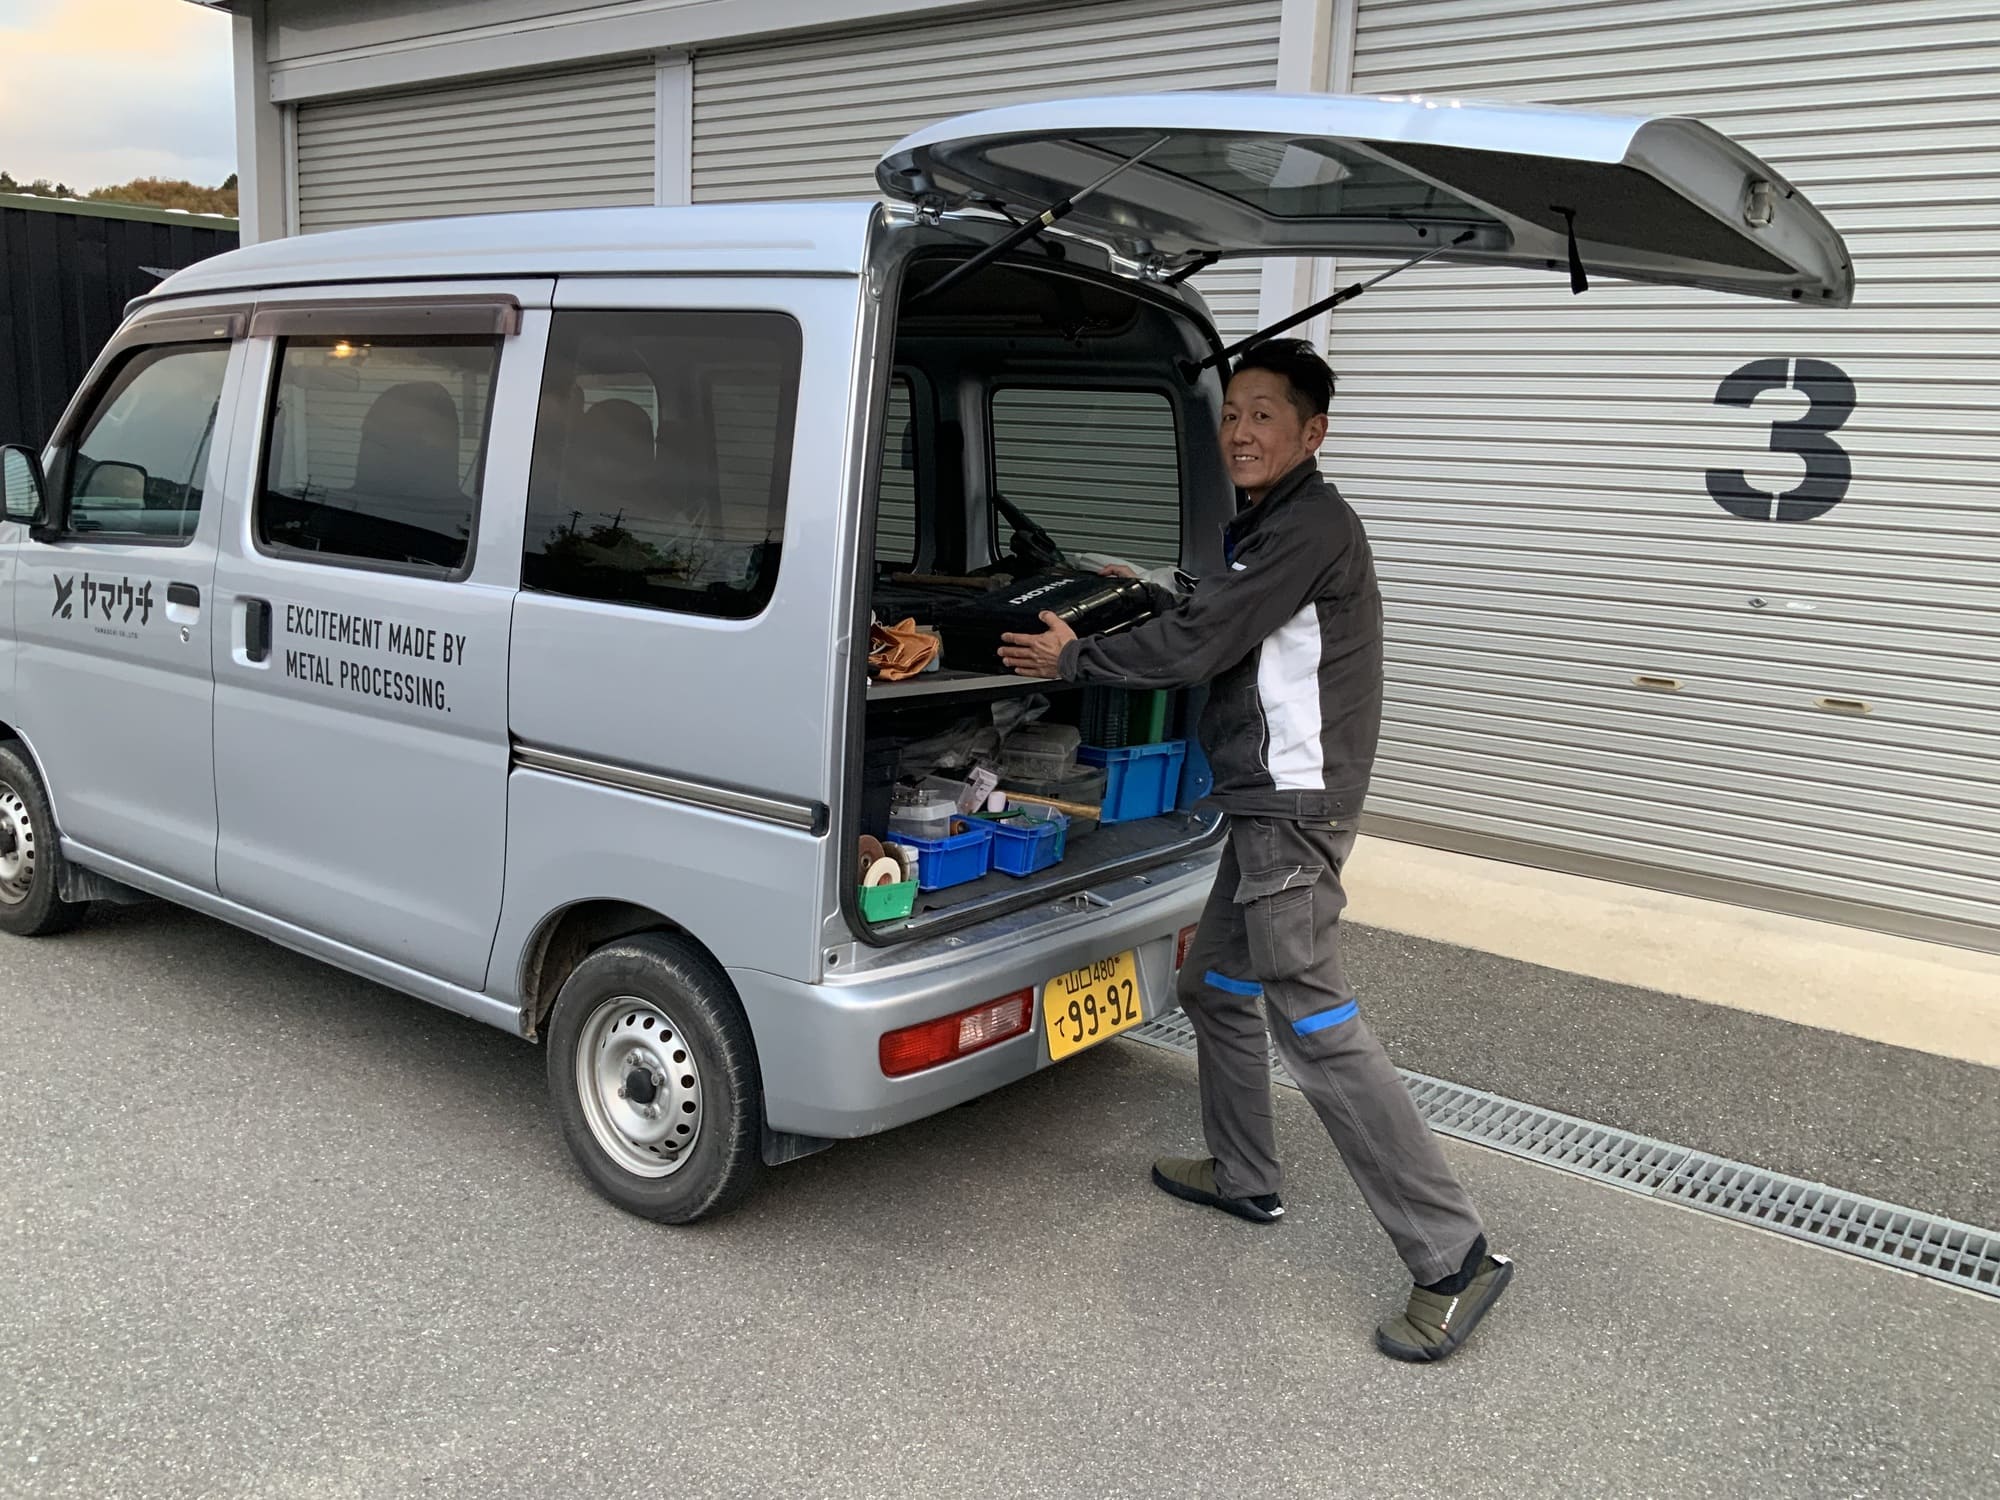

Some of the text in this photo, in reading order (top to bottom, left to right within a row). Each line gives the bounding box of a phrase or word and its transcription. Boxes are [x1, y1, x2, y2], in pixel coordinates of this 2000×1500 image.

[1705, 357, 1857, 522] 3
[81, 572, 153, 626] ヤマウチ
[286, 604, 467, 666] EXCITEMENT MADE BY
[286, 649, 451, 713] METAL PROCESSING.
[1068, 979, 1137, 1043] 99-92
